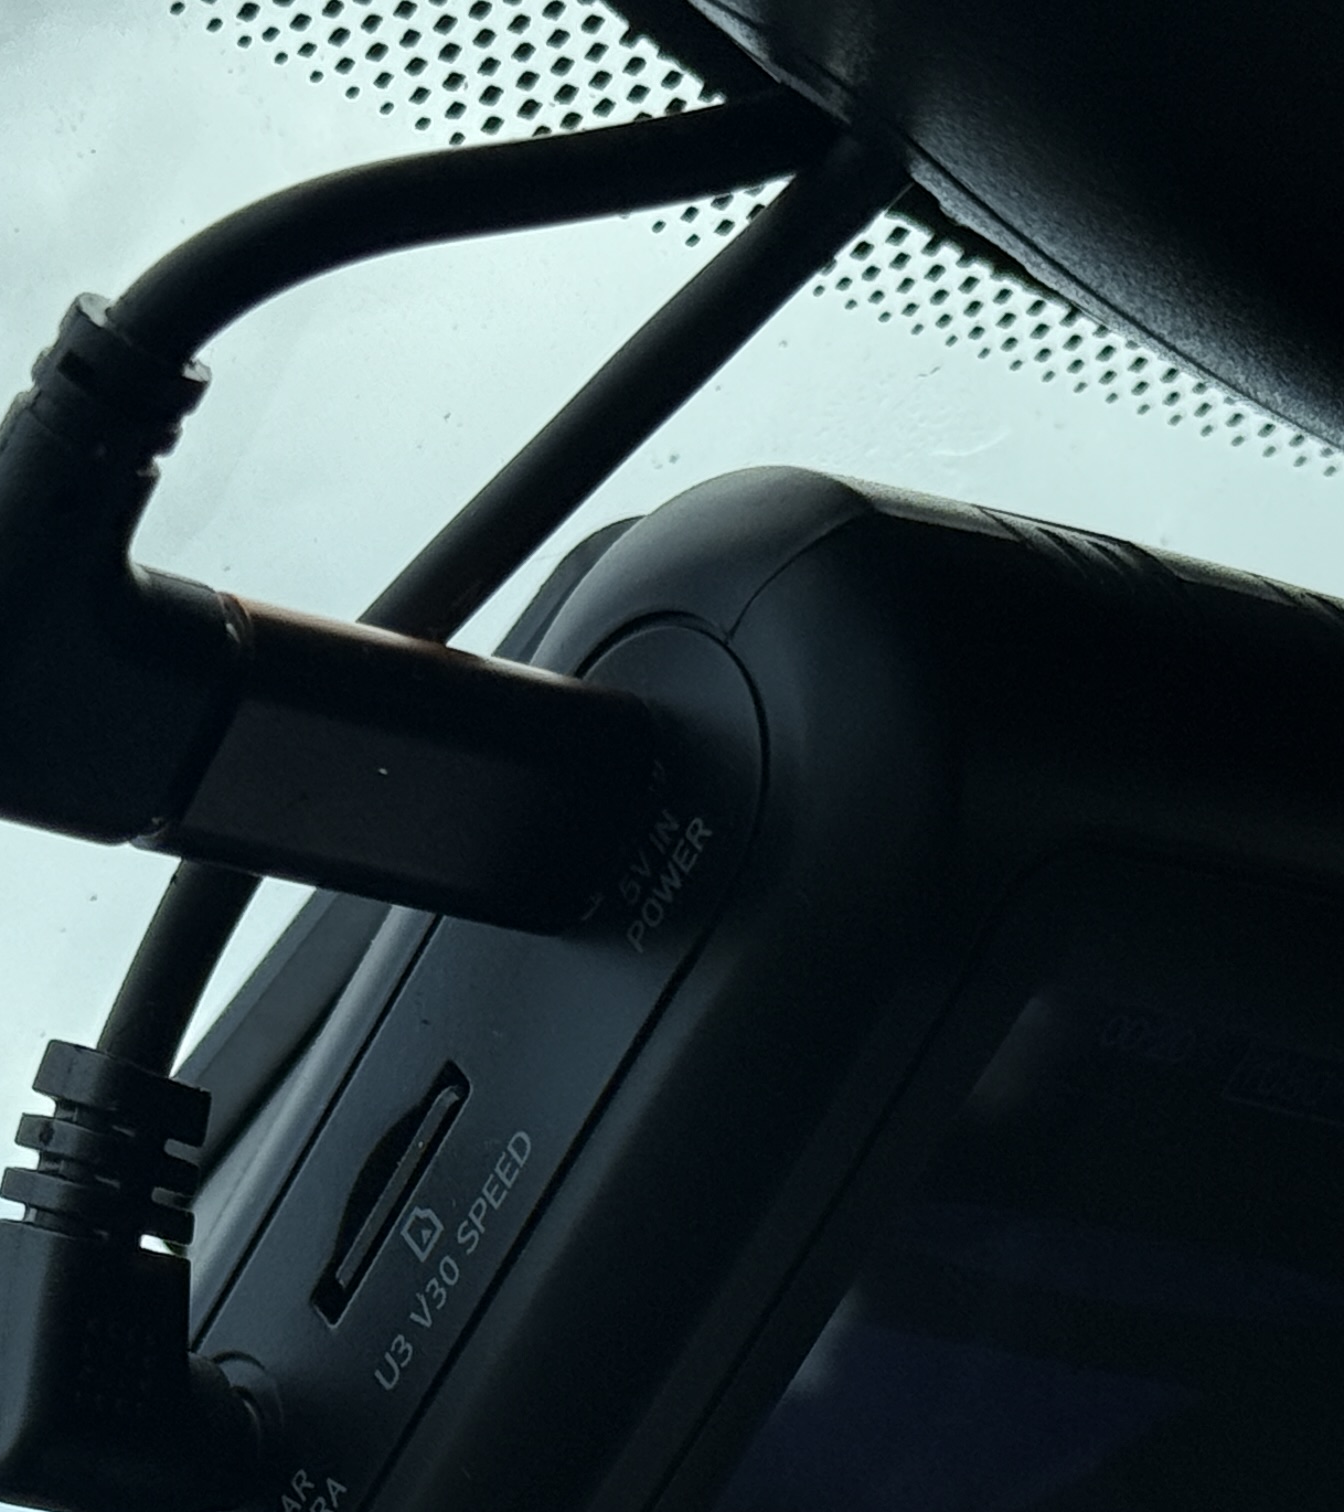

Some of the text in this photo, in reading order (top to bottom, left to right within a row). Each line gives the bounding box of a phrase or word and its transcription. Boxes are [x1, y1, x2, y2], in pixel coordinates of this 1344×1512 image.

[619, 809, 680, 905] 5V IN
[626, 817, 713, 953] POWER
[374, 1131, 532, 1392] U3 V30 SPEED
